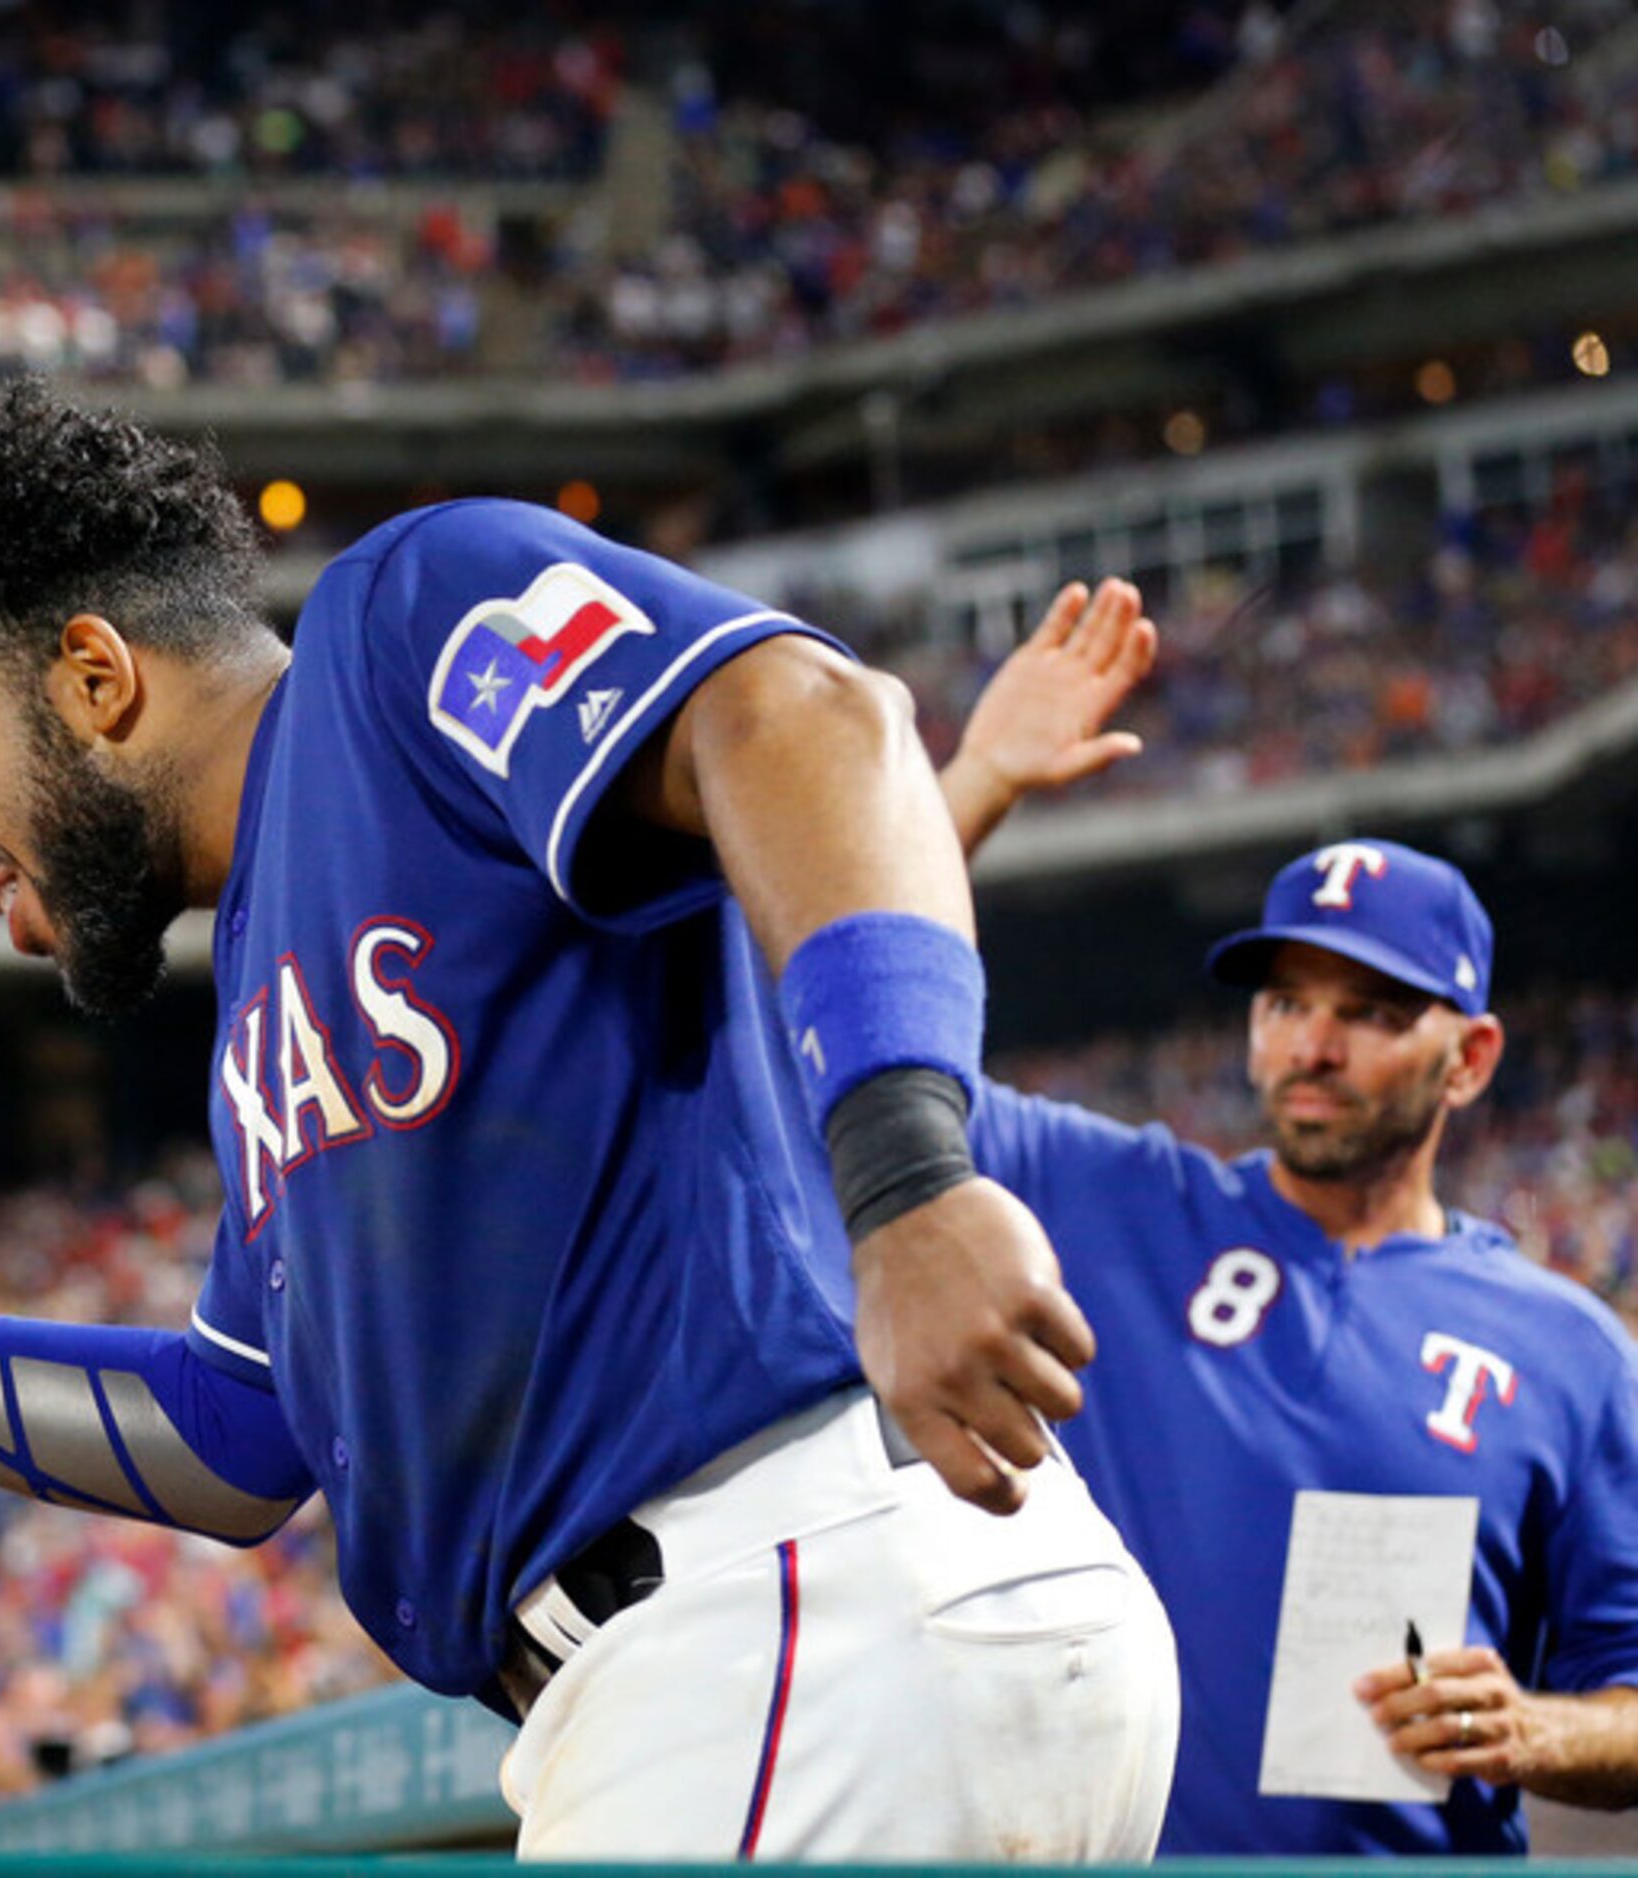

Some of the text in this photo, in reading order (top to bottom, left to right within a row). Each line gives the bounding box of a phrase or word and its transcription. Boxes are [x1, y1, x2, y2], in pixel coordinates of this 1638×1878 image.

[1312, 843, 1388, 910] T
[1188, 1247, 1282, 1347] 8
[1420, 1331, 1518, 1453] T
